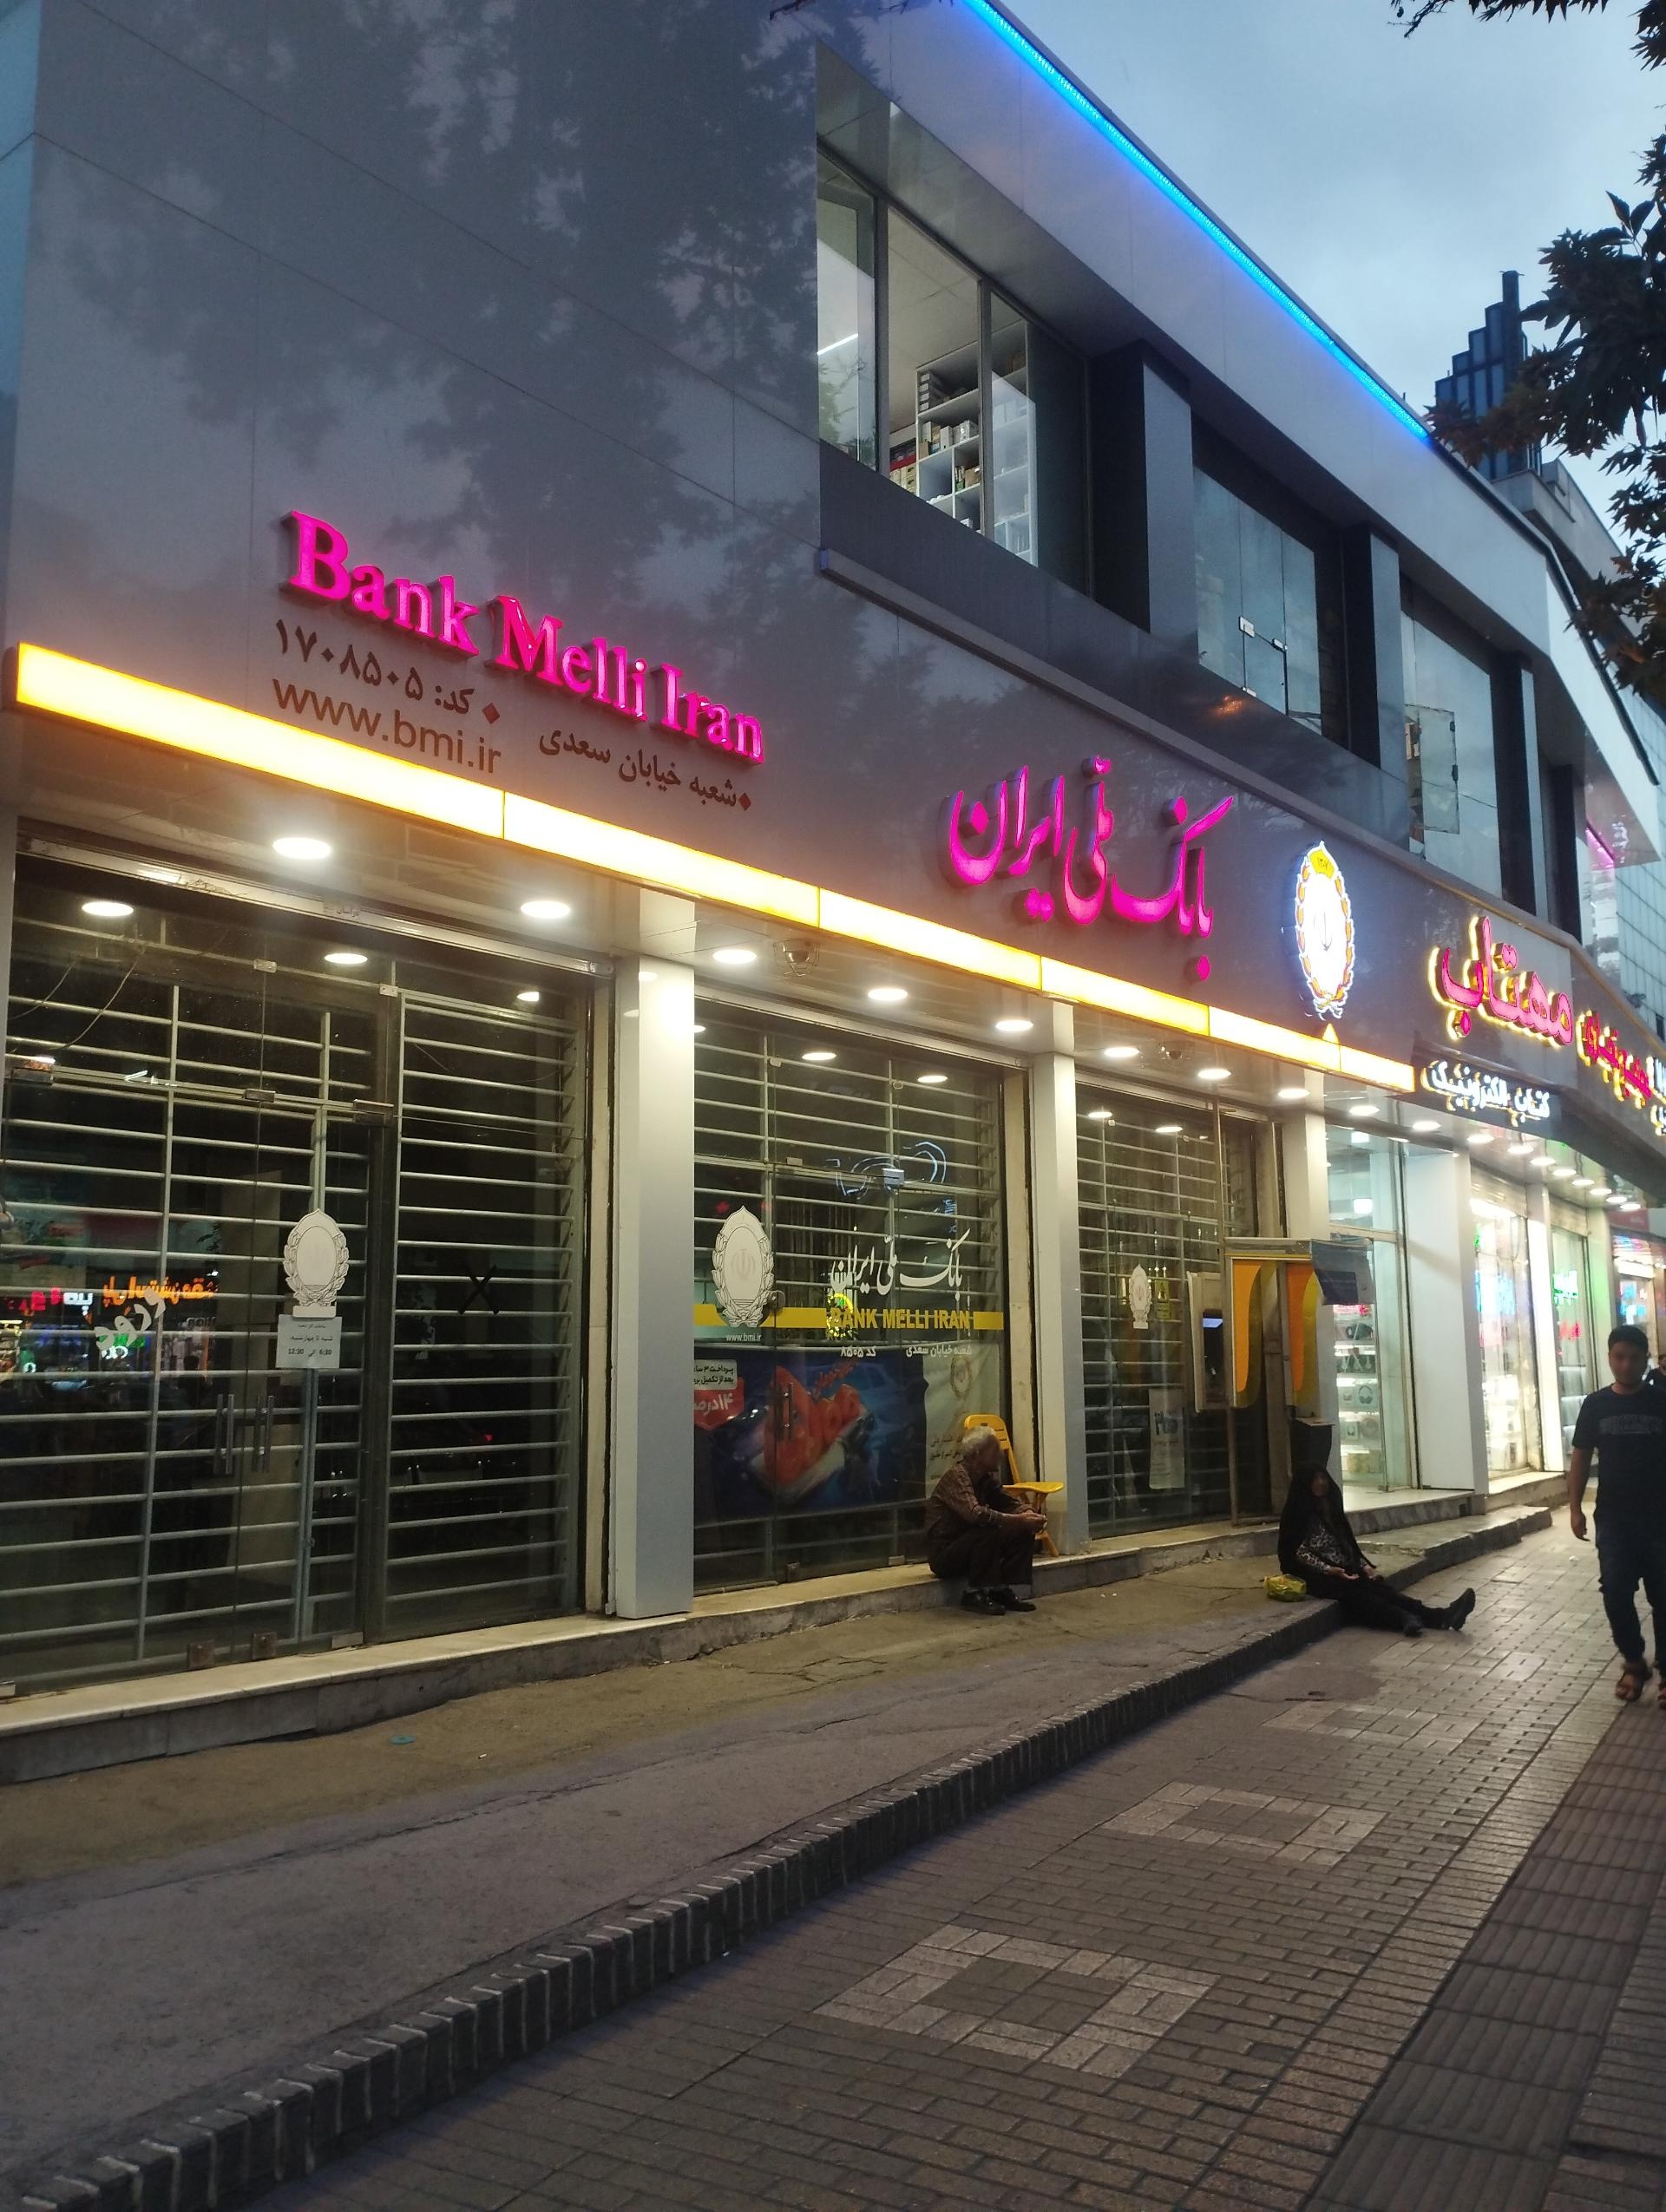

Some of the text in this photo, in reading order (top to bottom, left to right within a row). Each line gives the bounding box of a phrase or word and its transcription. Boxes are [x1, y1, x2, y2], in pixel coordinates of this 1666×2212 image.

[276, 618, 423, 701] ۱۷۰۸۵۰۵
[283, 510, 764, 765] Bank Melli Iran
[272, 678, 502, 774] www.bmi.ir
[538, 727, 738, 808] شعبه خیابان سعدی
[949, 764, 1065, 923] ایران
[1111, 795, 1235, 982] بانک
[93, 1288, 167, 1351] ورود
[725, 1332, 762, 1343] www.bmi.ir
[830, 1307, 969, 1330] BANK MELLI IRAN
[694, 1397, 718, 1416] درص
